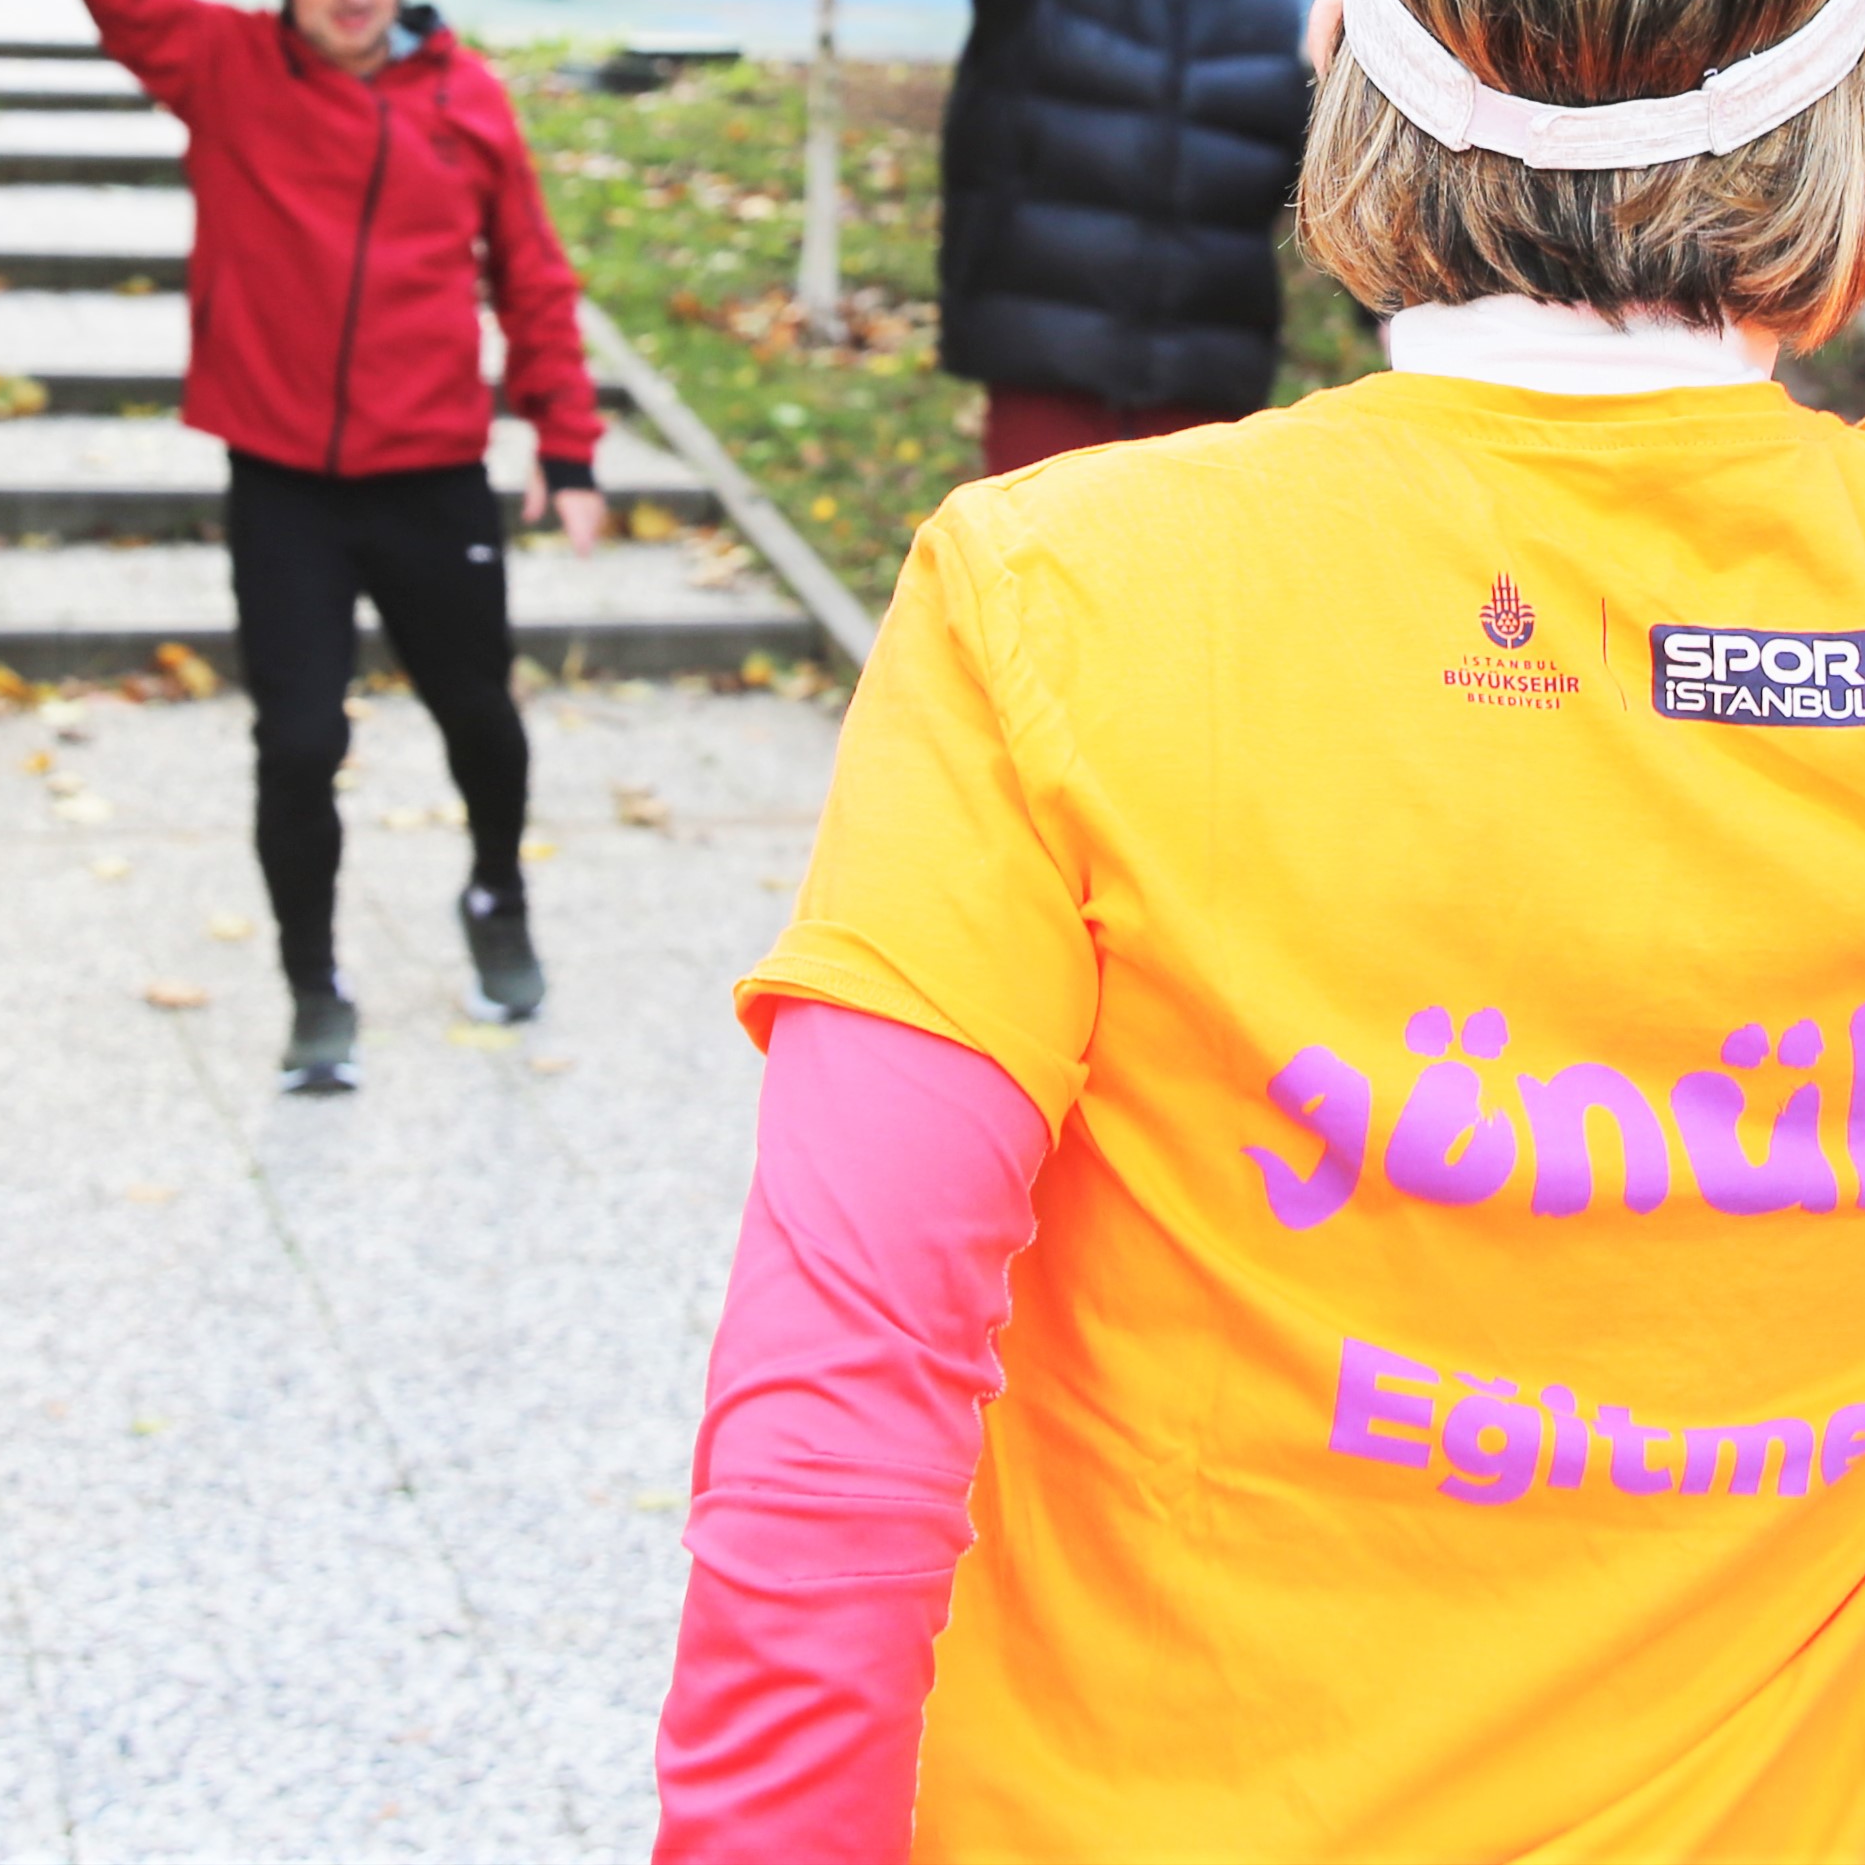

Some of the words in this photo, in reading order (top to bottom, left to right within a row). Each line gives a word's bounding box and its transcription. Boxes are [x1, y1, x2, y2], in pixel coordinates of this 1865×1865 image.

[1663, 632, 1865, 687] SPOR
[1443, 667, 1580, 694] BÜYÜKŞEHİR
[1467, 692, 1560, 710] BELEDİYESİ
